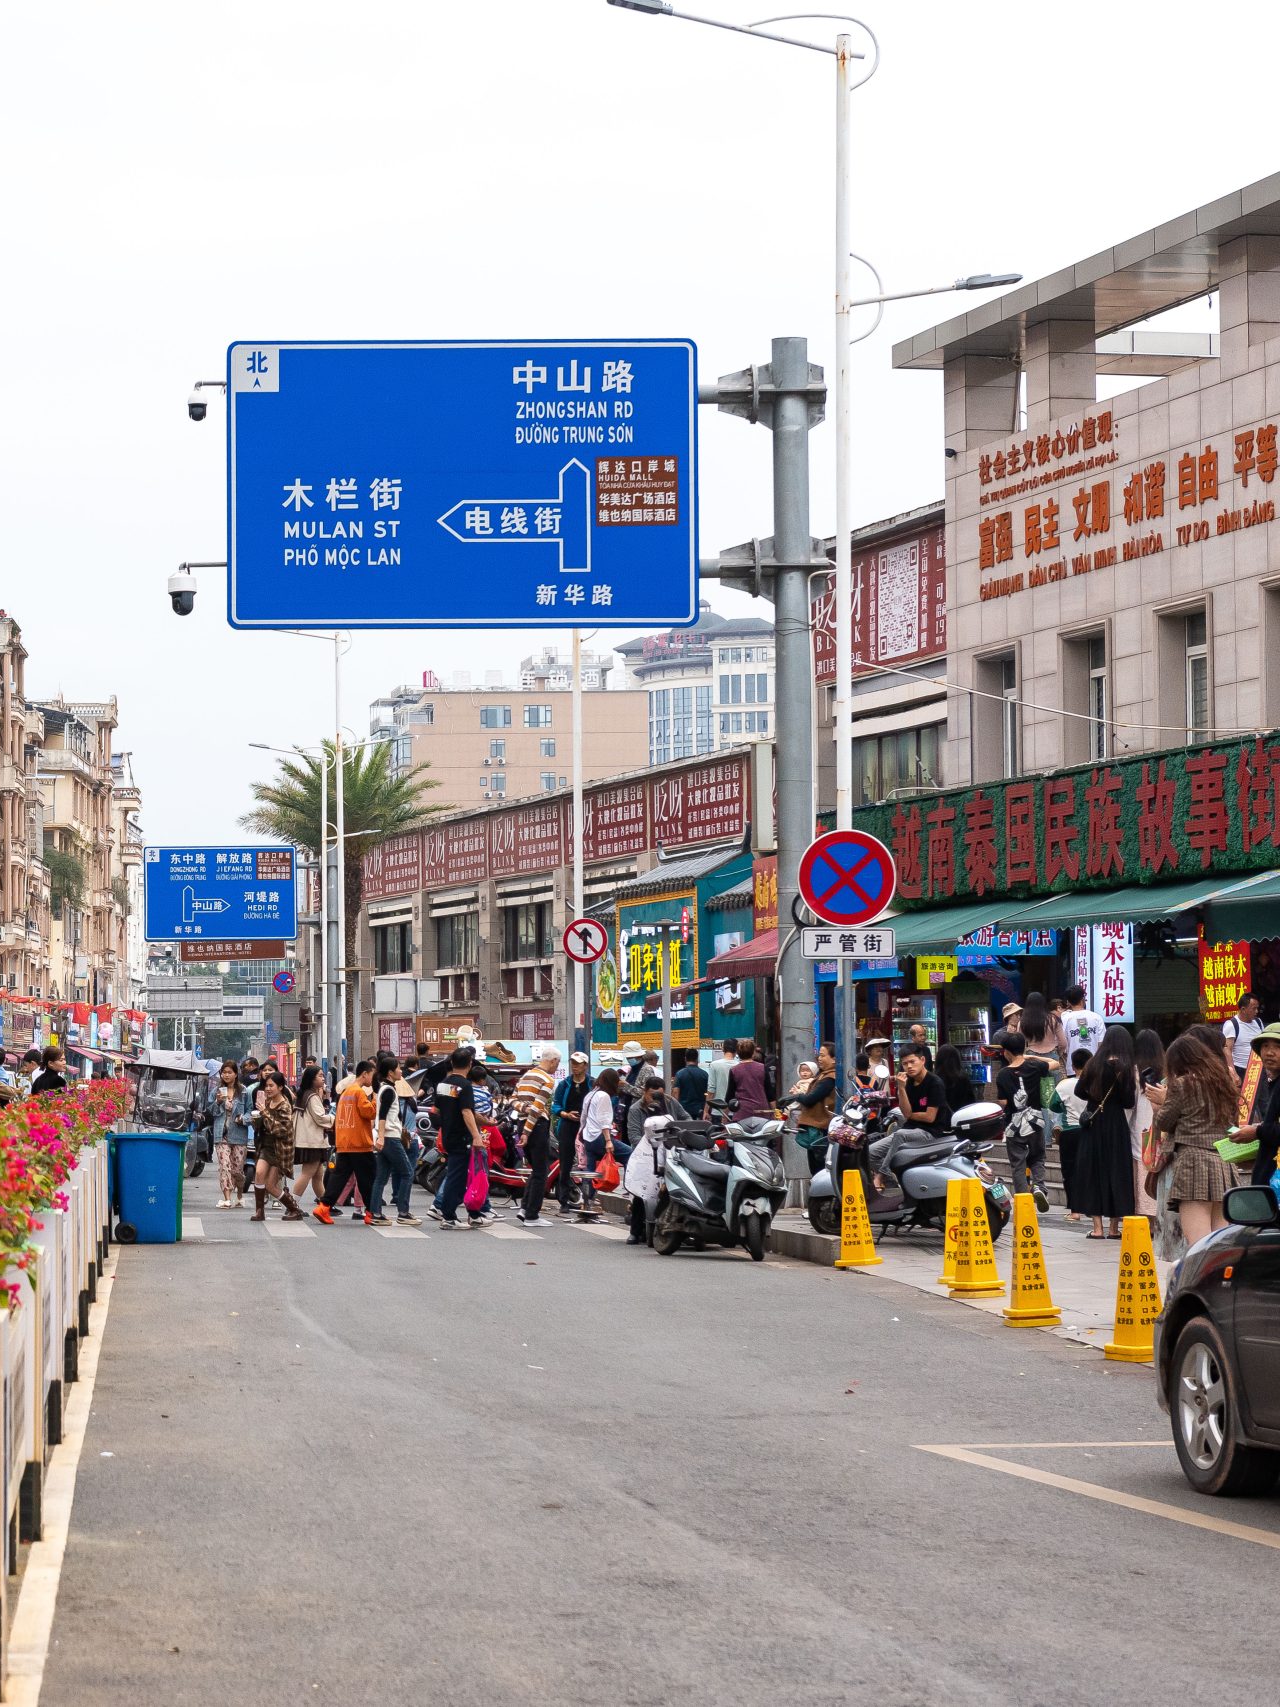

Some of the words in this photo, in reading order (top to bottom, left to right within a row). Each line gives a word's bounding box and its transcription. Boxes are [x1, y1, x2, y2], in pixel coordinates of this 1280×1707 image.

[246, 350, 268, 374] 北
[512, 360, 635, 394] 中山路
[516, 401, 607, 419] ZHONGSHAN
[614, 401, 633, 418] RD
[562, 426, 604, 443] TRUNG
[598, 459, 675, 474] 辉达口岸城
[629, 473, 653, 481] MALL
[281, 477, 403, 512] 木栏街
[599, 492, 676, 506] 华美达广场酒店
[979, 511, 1013, 571] 富强
[1025, 497, 1060, 558] 民主
[1072, 480, 1110, 542] 文明
[1123, 461, 1165, 526] 和谐
[1178, 444, 1218, 511] 自由
[1233, 424, 1278, 488] 平等
[465, 506, 562, 535] 电线街
[599, 508, 676, 522] 维也纳国际酒店
[284, 521, 363, 538] MULAN
[373, 520, 401, 538] ST
[1193, 520, 1210, 542] DO
[325, 544, 361, 570] MỘC
[367, 548, 401, 566] LAN
[536, 584, 613, 606] 新华路
[816, 625, 862, 653] BLK
[891, 737, 1280, 899] 越南泰国民族故事街
[170, 853, 206, 865] 东中路
[216, 852, 253, 864] 解放路
[192, 901, 223, 911] 中山路
[243, 891, 280, 903] 河堤路
[174, 925, 203, 934] 新华路
[187, 943, 252, 953] 维也纳国际酒店
[813, 933, 883, 953] 严管街
[920, 962, 954, 971] 旅游咨询
[1202, 953, 1247, 981] 越南铁木
